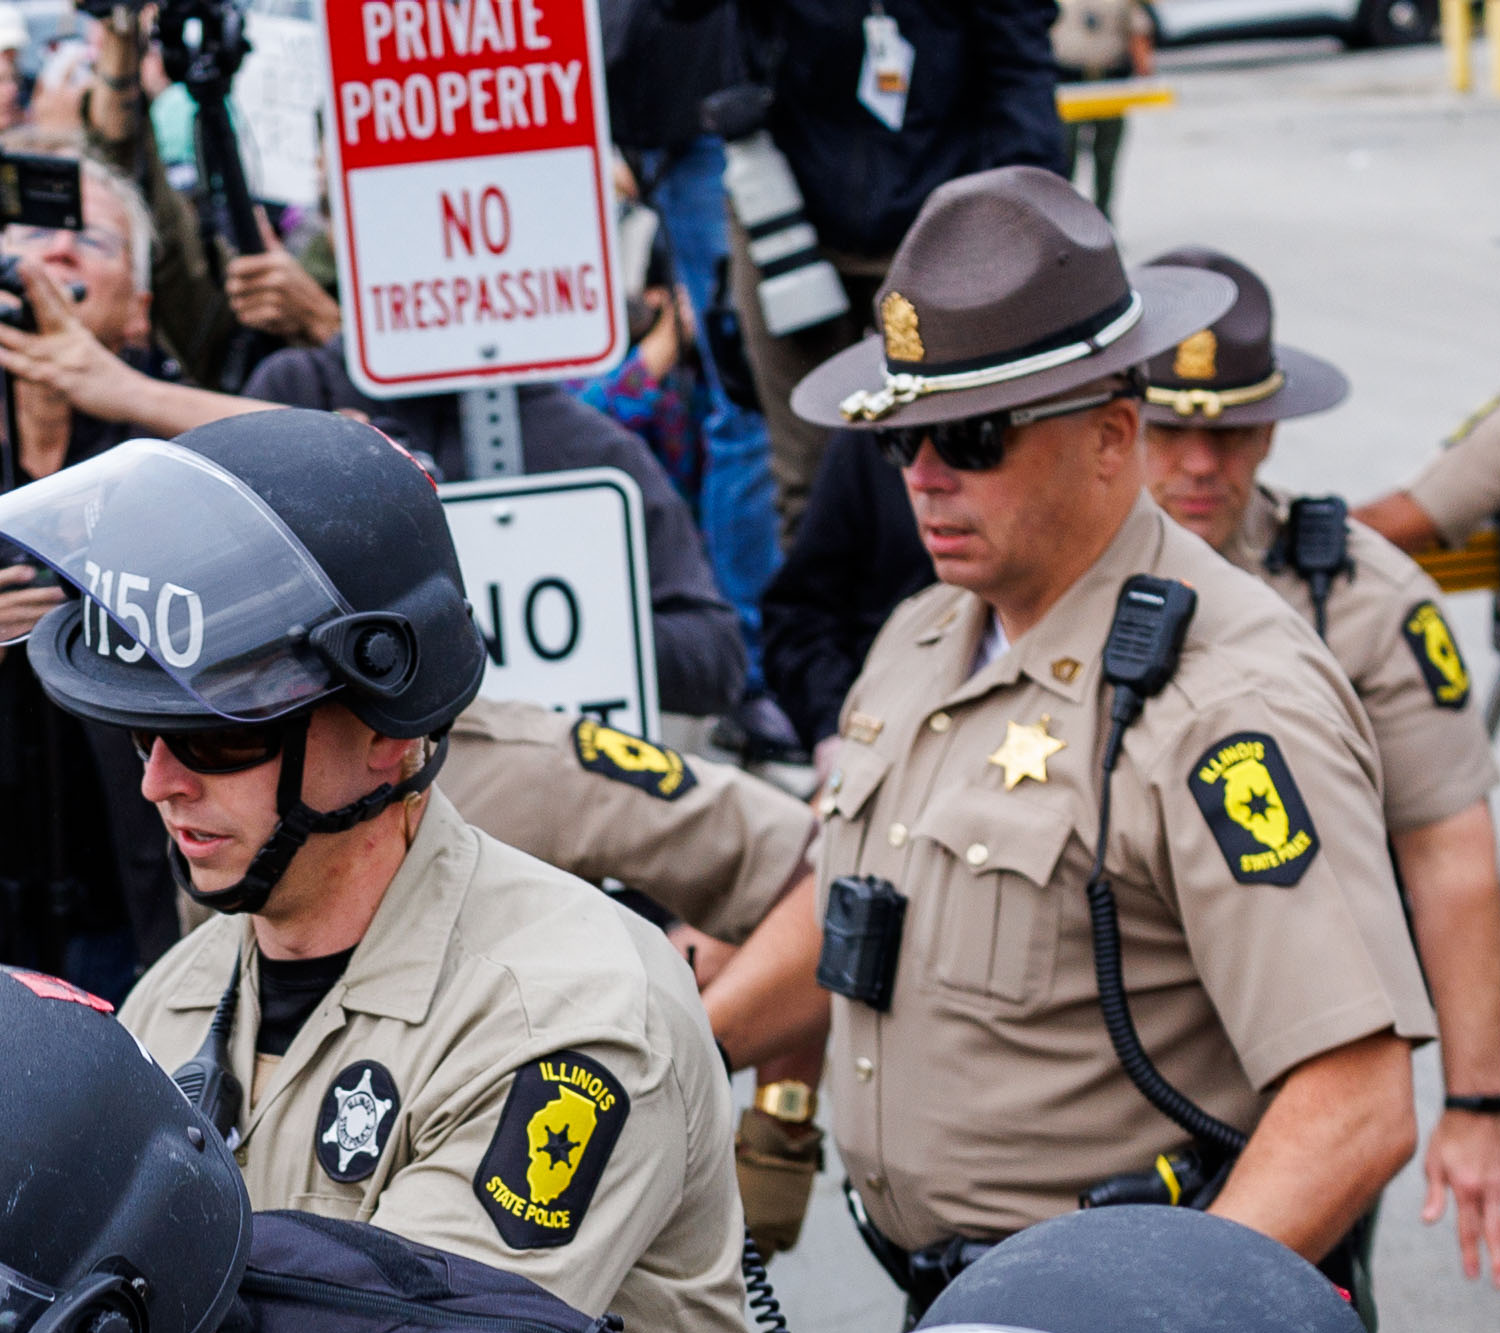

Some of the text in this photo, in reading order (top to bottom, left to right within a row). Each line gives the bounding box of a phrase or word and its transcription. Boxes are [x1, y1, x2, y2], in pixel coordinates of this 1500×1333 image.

[362, 0, 552, 65] PRIVATE
[341, 60, 582, 145] PROPERTY
[440, 185, 512, 260] NO
[371, 264, 598, 332] TRESPASSING
[540, 1062, 615, 1112] ILLINOIS
[486, 1176, 571, 1229] STATE POLICE
